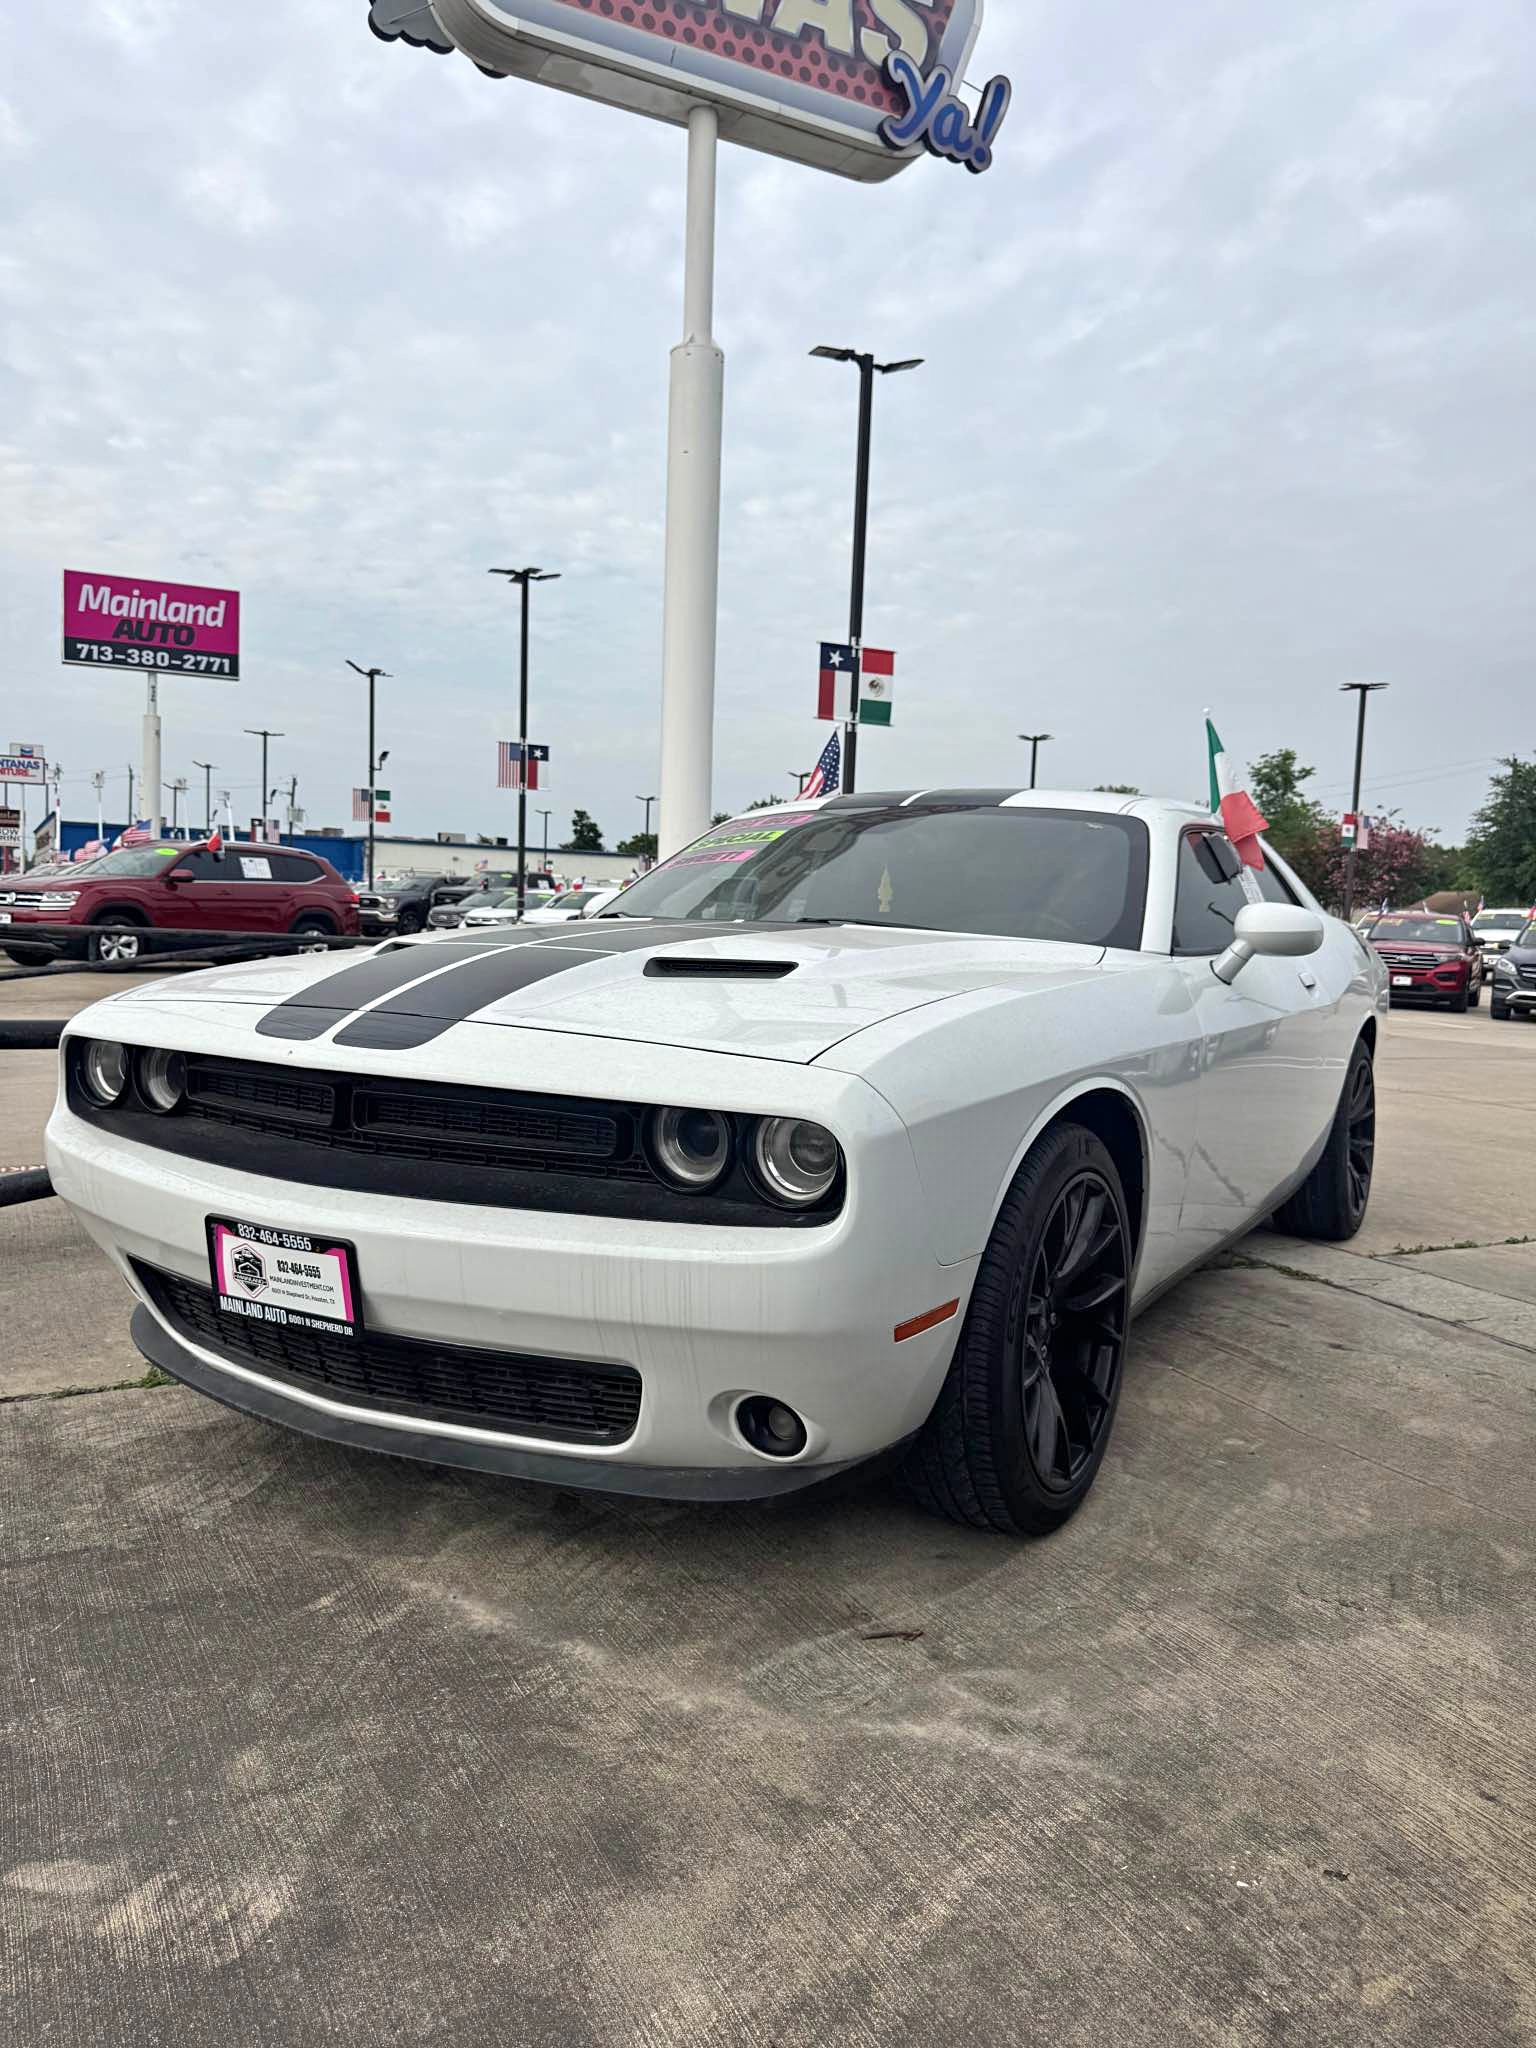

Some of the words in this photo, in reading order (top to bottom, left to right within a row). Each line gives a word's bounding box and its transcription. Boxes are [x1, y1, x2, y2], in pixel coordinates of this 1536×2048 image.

[690, 0, 934, 70] AS
[884, 53, 1007, 167] Ya!
[78, 584, 226, 628] Mainland
[112, 619, 196, 647] AUTO
[76, 643, 231, 673] 713-380-2771
[237, 1223, 312, 1251] 832-464-5555
[276, 1259, 322, 1280] 832-464-5555
[219, 1295, 263, 1319] MAINLAND
[264, 1305, 288, 1325] AUTO
[305, 1318, 311, 1327] N
[311, 1318, 344, 1334] SHEPHERD
